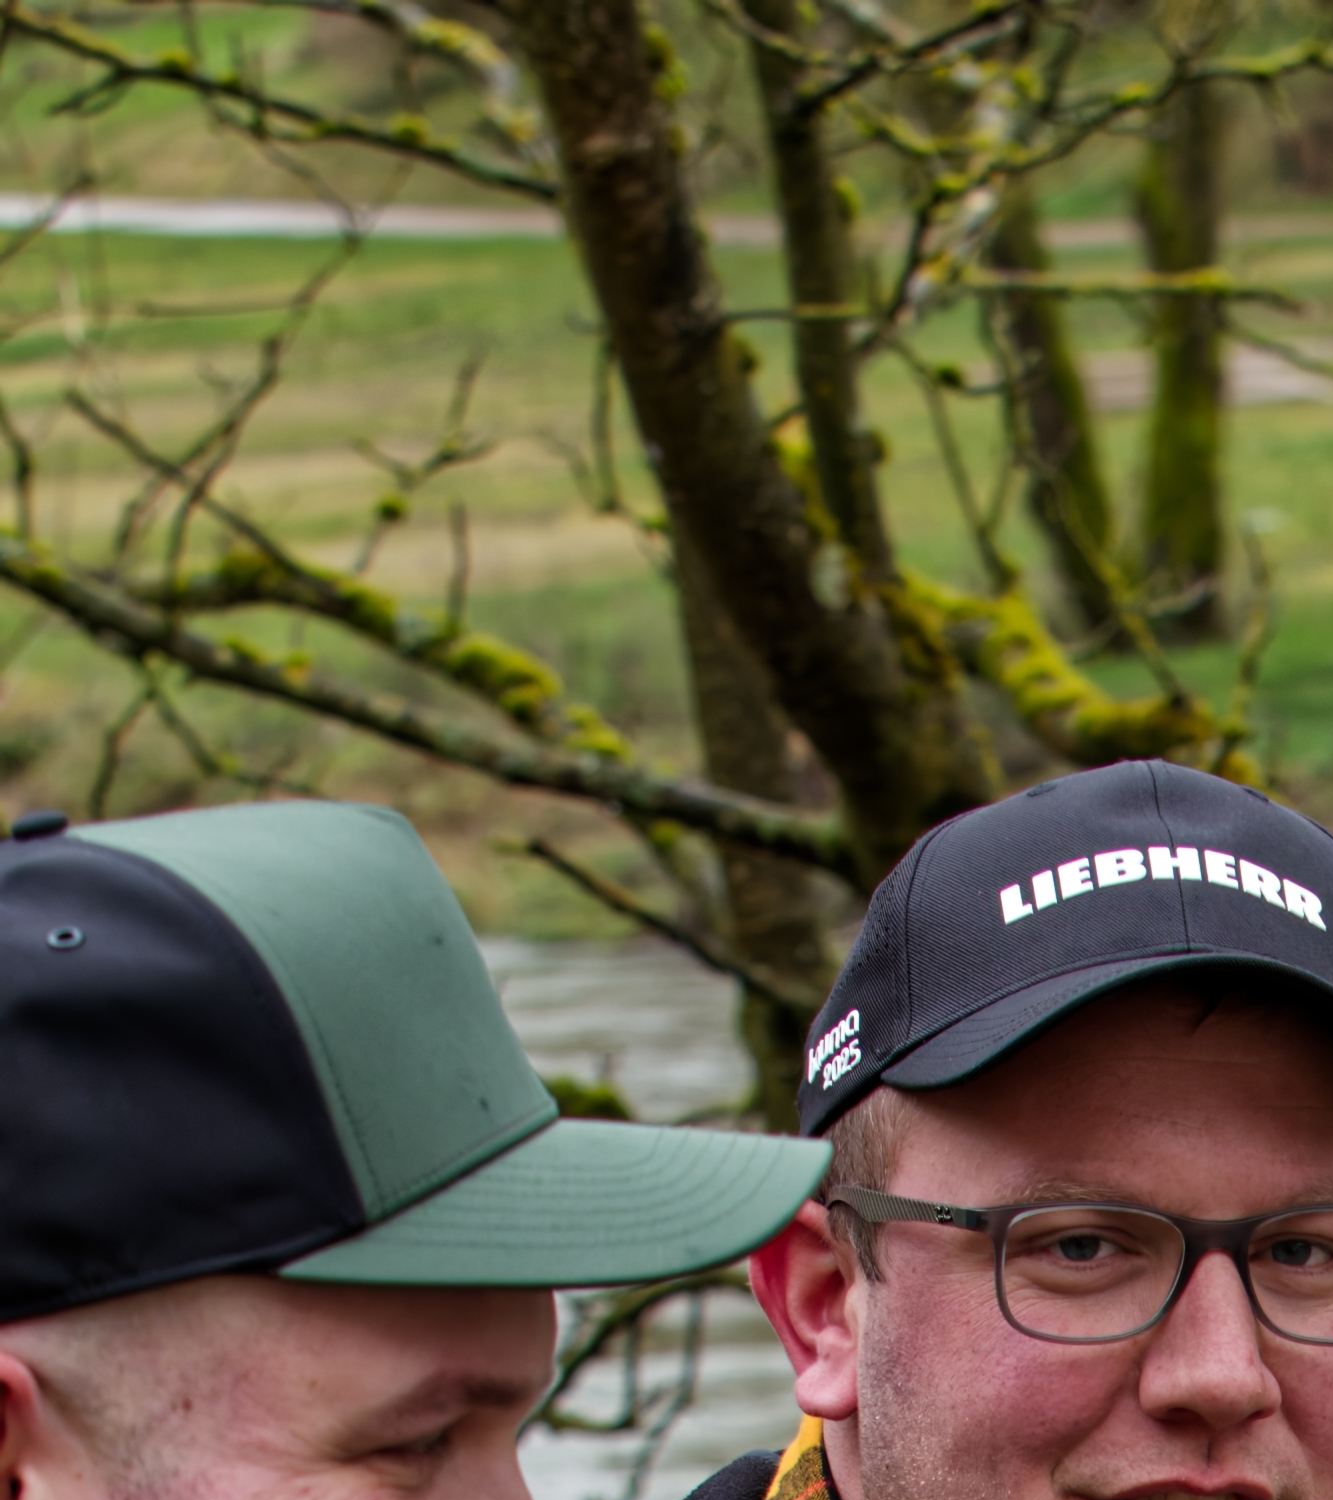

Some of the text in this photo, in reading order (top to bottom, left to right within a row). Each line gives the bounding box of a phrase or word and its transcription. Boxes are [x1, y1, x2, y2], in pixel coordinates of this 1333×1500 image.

[1000, 846, 1327, 931] LIEBHERR
[808, 1009, 860, 1084] bauma
[823, 1039, 861, 1091] 2025
